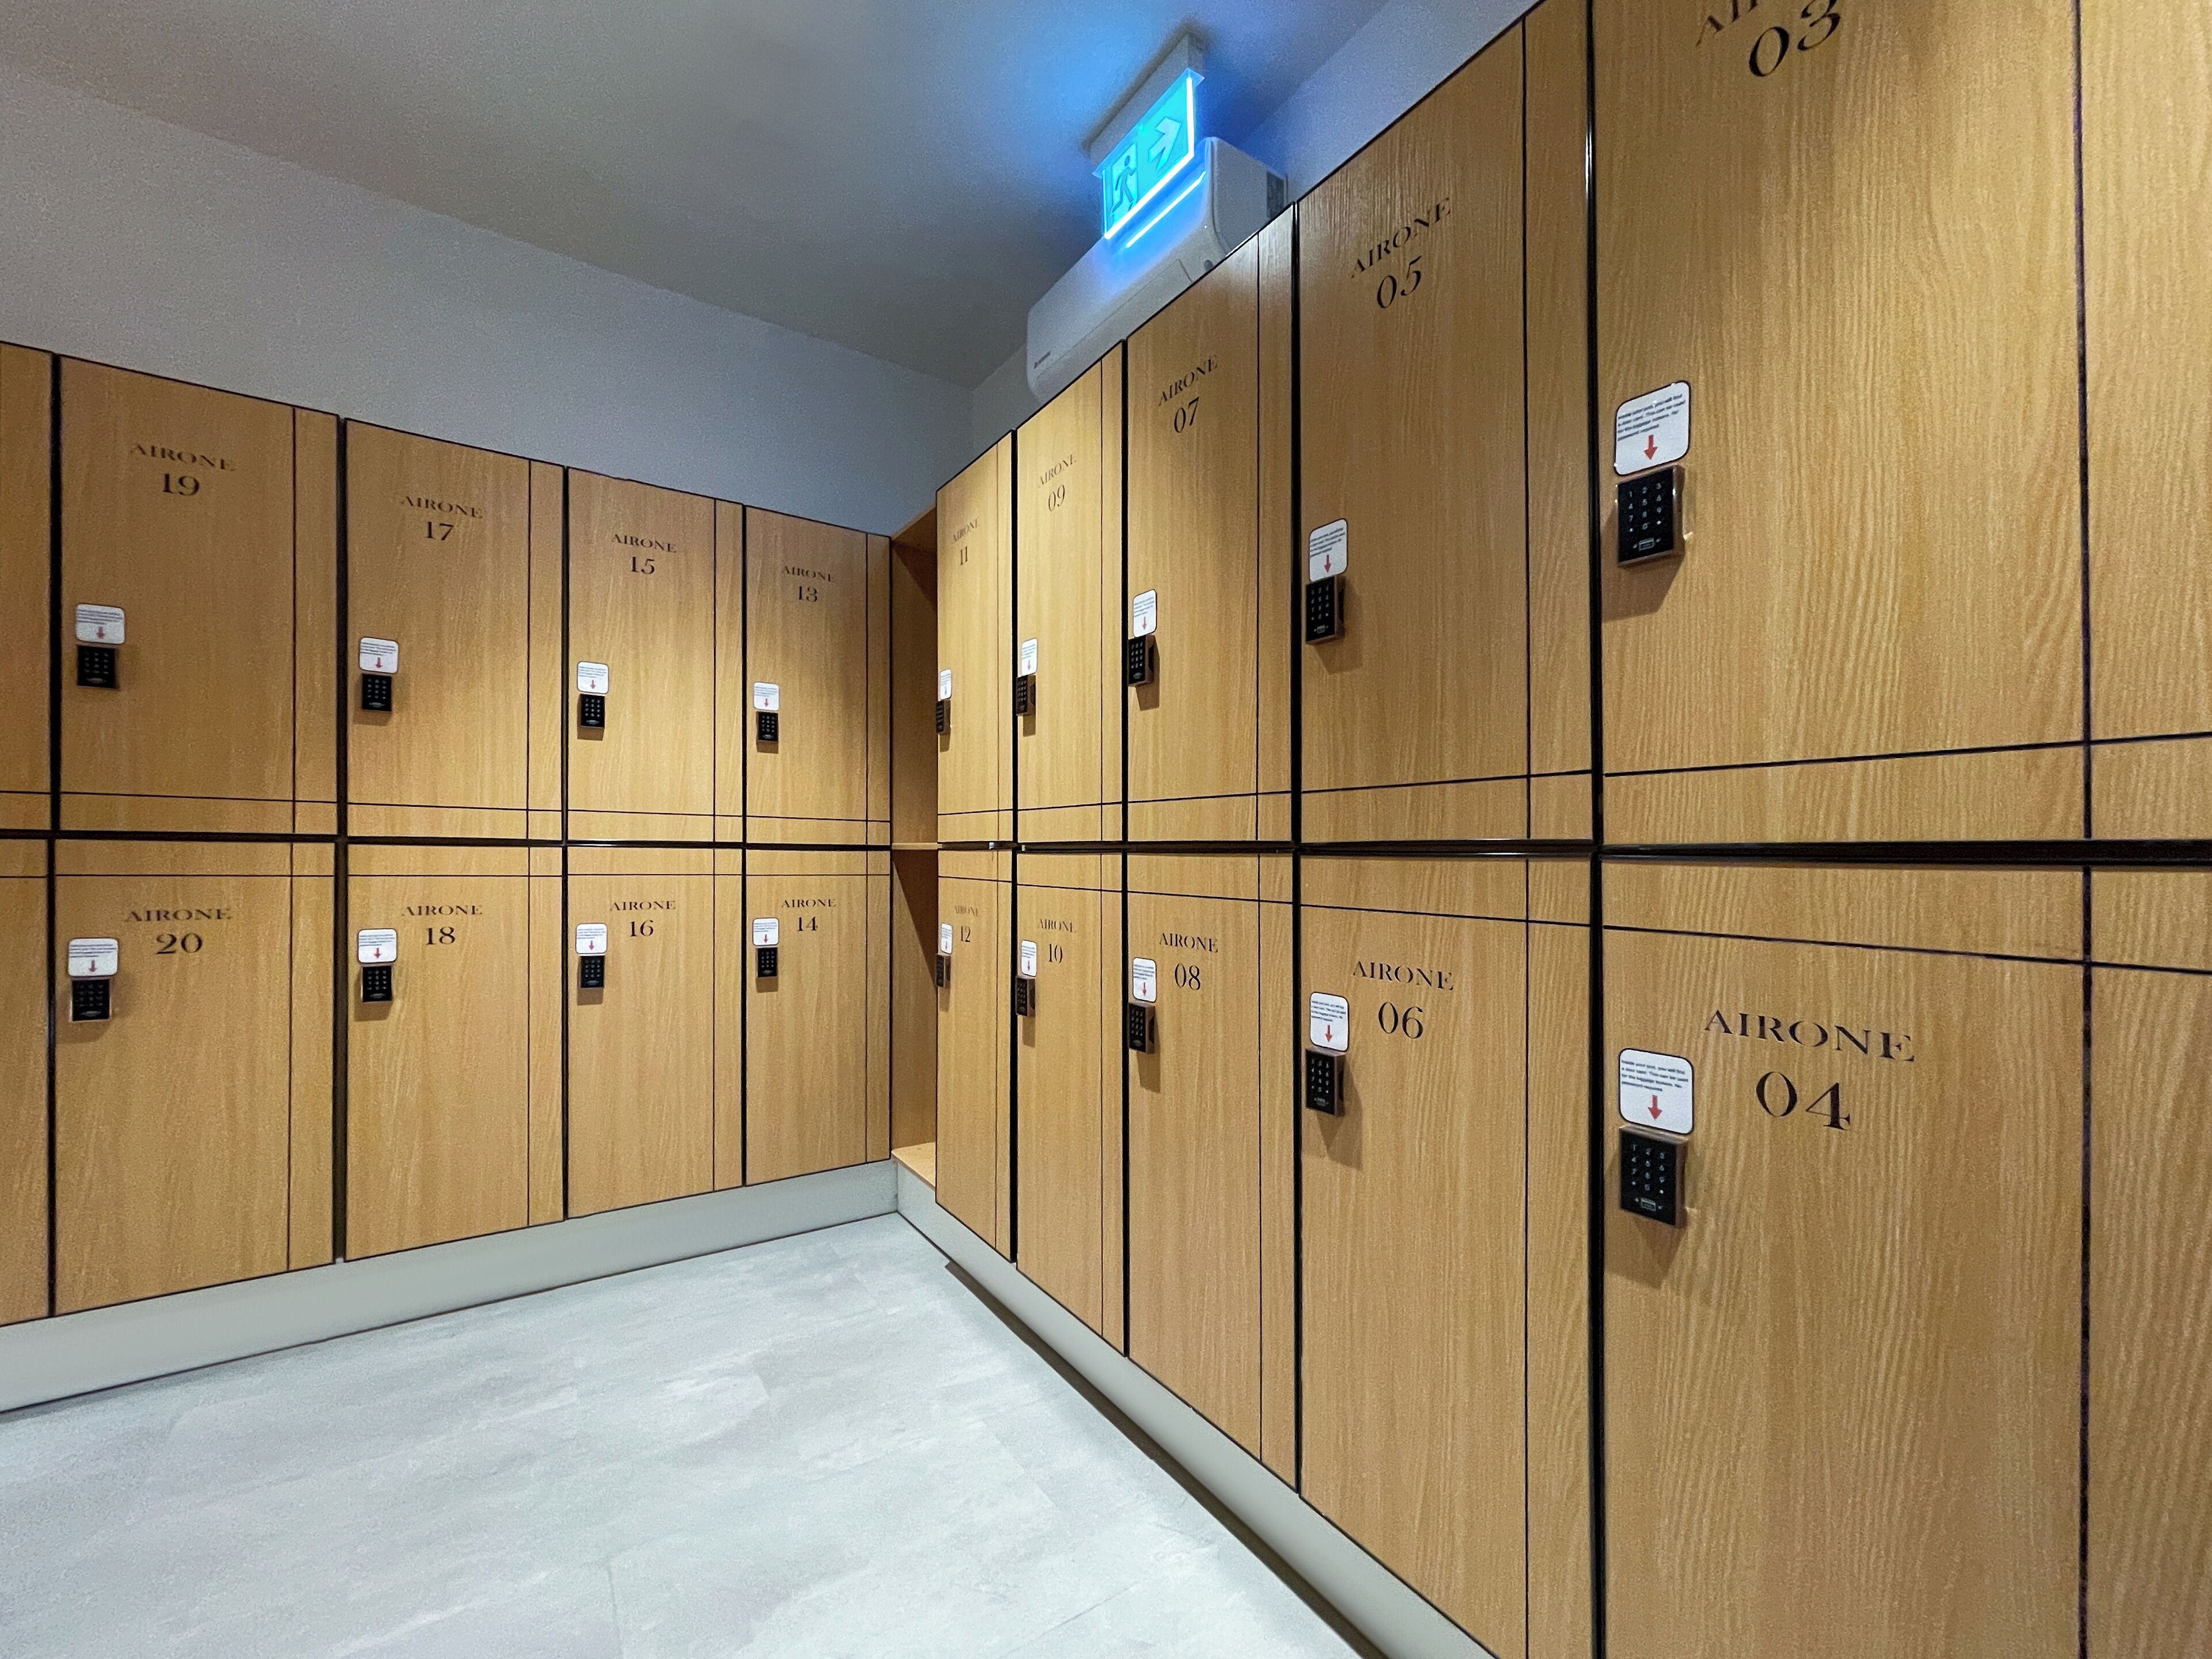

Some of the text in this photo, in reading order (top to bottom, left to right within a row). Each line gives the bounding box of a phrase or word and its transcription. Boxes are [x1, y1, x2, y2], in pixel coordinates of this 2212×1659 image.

[1748, 0, 1841, 77] 03
[1349, 196, 1452, 279] AIRONE
[1376, 255, 1422, 309] 05
[1158, 355, 1218, 406] AIRONE
[1173, 396, 1200, 433] 07
[131, 444, 236, 471] AIRONE
[162, 474, 199, 495] 19
[400, 495, 483, 518] AIRONE
[1048, 485, 1065, 511] 09
[427, 522, 454, 540] 17
[612, 533, 677, 553] AIRONE
[632, 556, 654, 574] 15
[960, 546, 968, 566] 11
[782, 565, 835, 582] AIRONE
[799, 586, 817, 602] 13
[402, 905, 483, 916] AIRONE
[611, 900, 676, 911] AIRONE
[782, 899, 836, 908] AIRONE
[126, 908, 233, 922] AIRONE
[798, 916, 818, 931] 14
[426, 927, 455, 945] 18
[631, 920, 653, 937] 16
[961, 926, 971, 942] 12
[156, 933, 203, 955] 20
[1159, 933, 1218, 953] AIRONE
[1049, 944, 1063, 963] 10
[1175, 964, 1200, 990] 08
[1353, 961, 1455, 991] AIRONE
[1378, 1002, 1423, 1039] 06
[1704, 1009, 1915, 1062] AIRONE
[1756, 1071, 1850, 1130] 04
